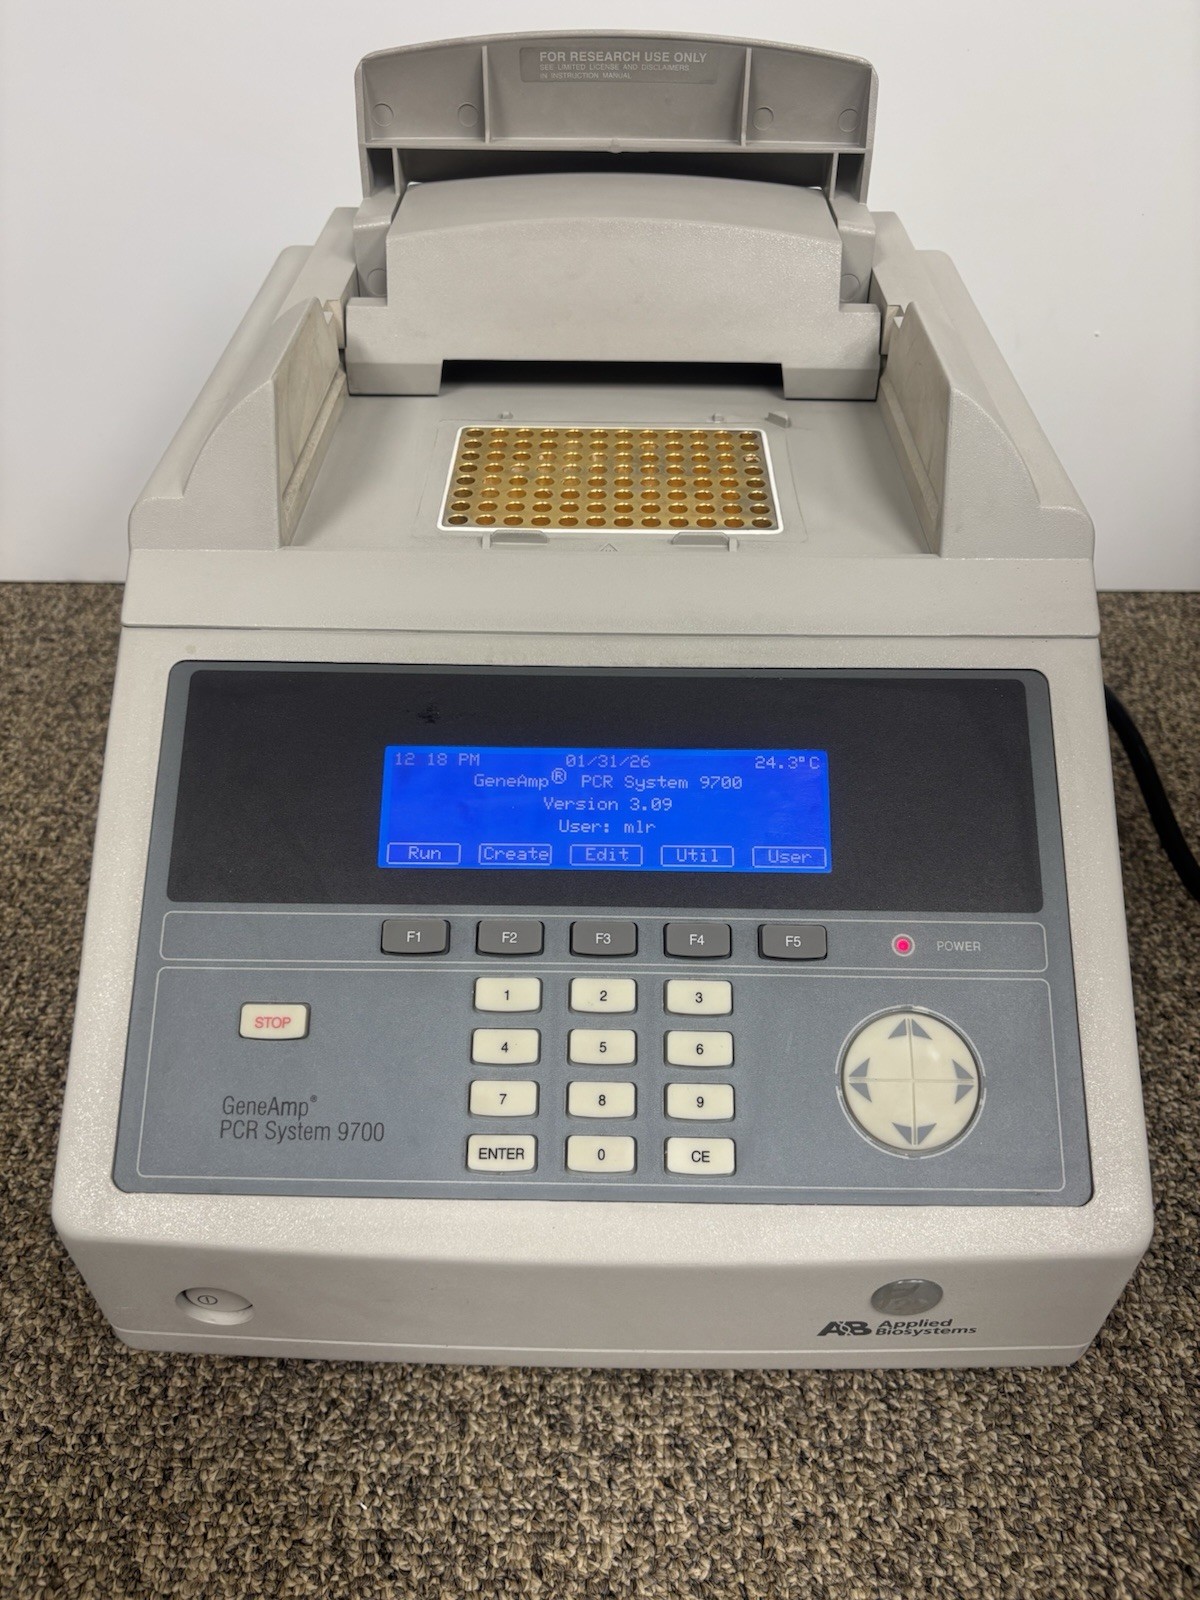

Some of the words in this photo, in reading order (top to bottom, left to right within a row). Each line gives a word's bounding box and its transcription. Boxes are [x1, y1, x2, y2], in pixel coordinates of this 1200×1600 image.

[540, 51, 566, 62] FOR
[570, 51, 640, 62] RESEARCH
[644, 52, 670, 62] USE
[674, 52, 707, 63] ONLY
[641, 64, 690, 72] DISCLAIMERS
[395, 752, 415, 766] 12
[428, 752, 448, 767] 18
[458, 753, 480, 767] PM
[565, 754, 651, 768] 01/31/26
[755, 756, 820, 770] 24.3°C
[581, 775, 613, 788] PCR
[624, 775, 688, 792] System
[700, 776, 743, 790] 9700
[543, 797, 619, 811] Version
[630, 798, 673, 812] 3.09
[558, 819, 610, 834] User:
[624, 820, 656, 834] mlr
[407, 846, 442, 861] Run
[483, 846, 549, 861] Create
[585, 847, 629, 862] Edit
[676, 849, 719, 863] Util
[768, 849, 812, 864] User
[406, 931, 421, 943] F1
[501, 932, 517, 943] F2
[595, 933, 611, 945] F3
[689, 934, 705, 946] F4
[785, 936, 801, 947] F5
[936, 941, 981, 952] POWER
[504, 990, 510, 1001] 1
[599, 990, 608, 1002] 2
[695, 992, 703, 1003] 3
[254, 1016, 291, 1028] STOP
[501, 1042, 509, 1053] 4
[599, 1042, 607, 1053] 5
[696, 1044, 704, 1055] 6
[499, 1094, 507, 1105] 7
[598, 1095, 606, 1106] 8
[696, 1096, 704, 1108] 9
[219, 1119, 258, 1140] PCR
[265, 1120, 331, 1144] System
[338, 1121, 385, 1142] 9700
[478, 1148, 525, 1160] ENTER
[597, 1149, 606, 1160] 0
[691, 1151, 710, 1163] CE
[878, 1319, 953, 1329] Applied
[875, 1326, 977, 1337] Biosystems
